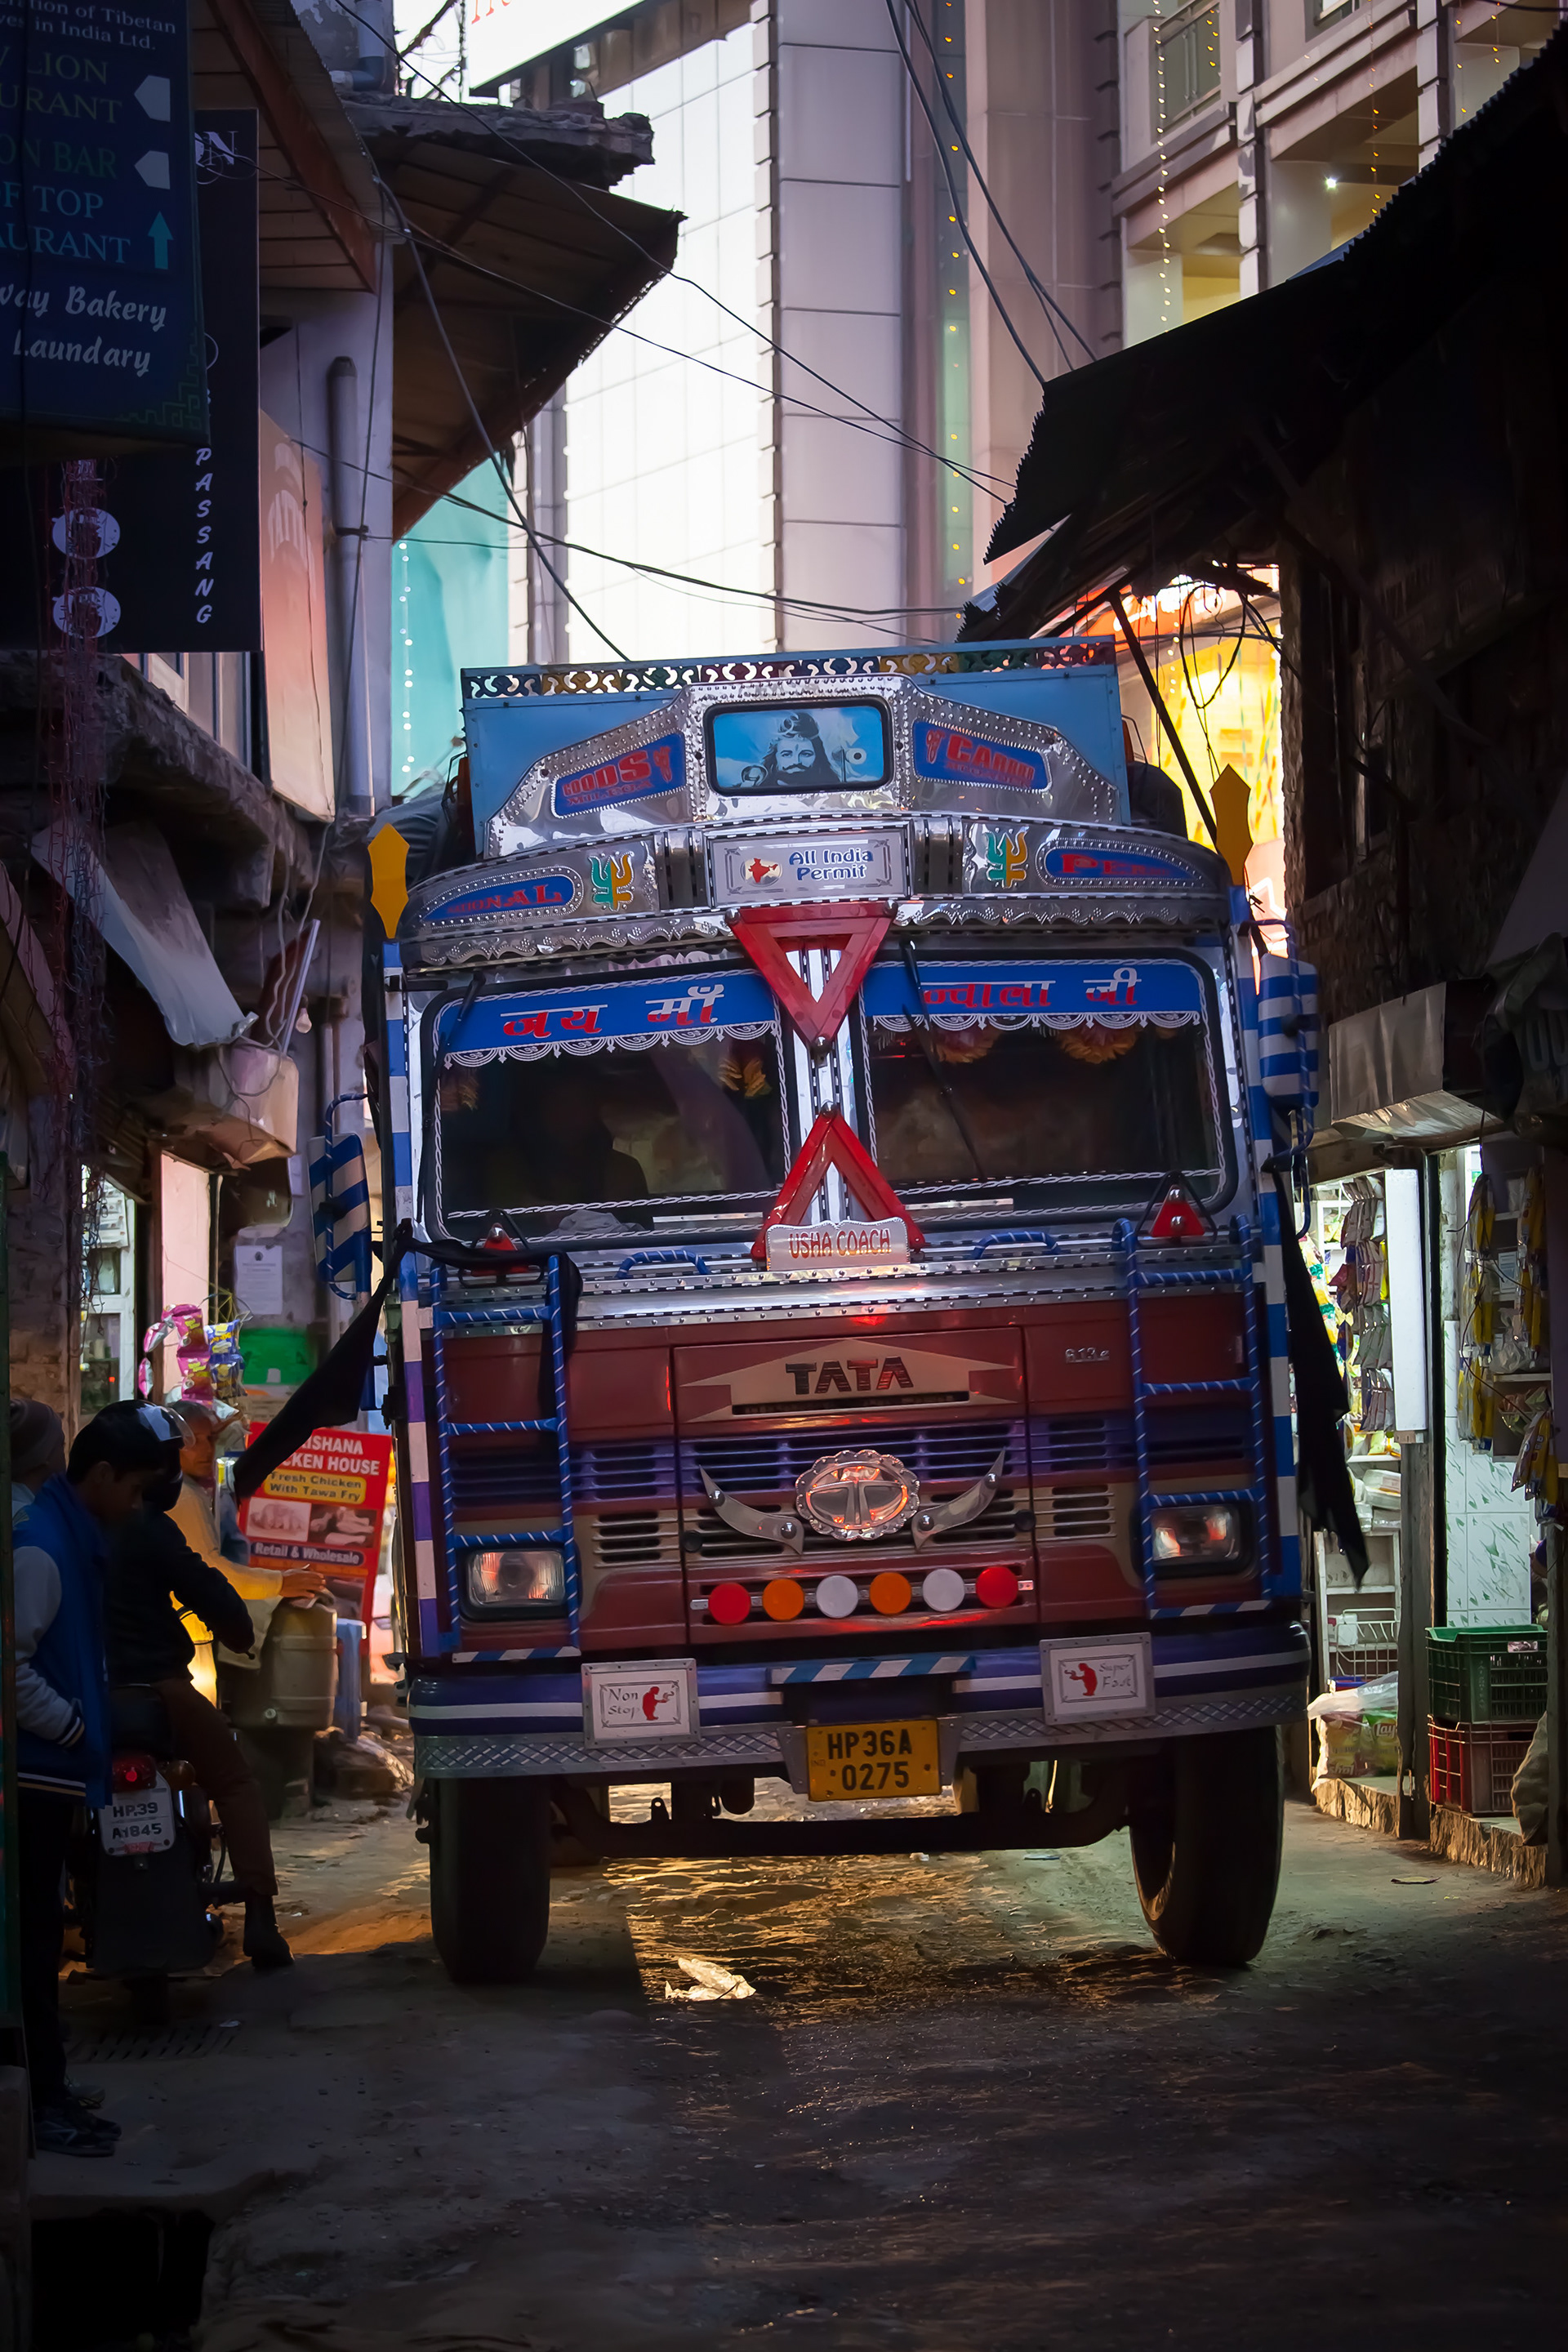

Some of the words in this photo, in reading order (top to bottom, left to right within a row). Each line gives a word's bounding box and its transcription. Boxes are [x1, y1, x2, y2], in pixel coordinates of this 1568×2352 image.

[0, 0, 69, 16] tion
[75, 5, 96, 20] of
[100, 7, 176, 34] Tibetan
[34, 16, 54, 33] in
[60, 20, 111, 42] India
[118, 30, 156, 51] Ltd.
[52, 140, 118, 180] BAR
[0, 180, 21, 208] F
[33, 185, 104, 219] TOP
[0, 222, 131, 264] URANT
[65, 286, 167, 332] Bakery
[13, 328, 150, 378] Laundary
[194, 448, 214, 624] PASSANG
[563, 750, 652, 797] GOODS
[789, 850, 817, 866] All
[824, 848, 874, 864] India
[796, 864, 867, 881] Permit
[1083, 967, 1143, 1005] जी
[500, 1004, 608, 1039] जय
[789, 1232, 832, 1258] USHA
[836, 1227, 891, 1256] COACH
[785, 1356, 914, 1396] TATA
[270, 1471, 306, 1483] Fresh
[310, 1475, 362, 1489] Chicken
[327, 1456, 380, 1475] HOUSE
[270, 1483, 298, 1494] With
[303, 1486, 336, 1498] Tawa
[341, 1490, 361, 1502] Fry
[255, 1542, 288, 1557] Retail
[291, 1546, 300, 1557] &
[303, 1547, 359, 1564] Wholesale
[609, 1688, 639, 1701] Non
[608, 1705, 640, 1720] Stop
[827, 1729, 912, 1760] HP36A
[842, 1761, 909, 1791] 0275
